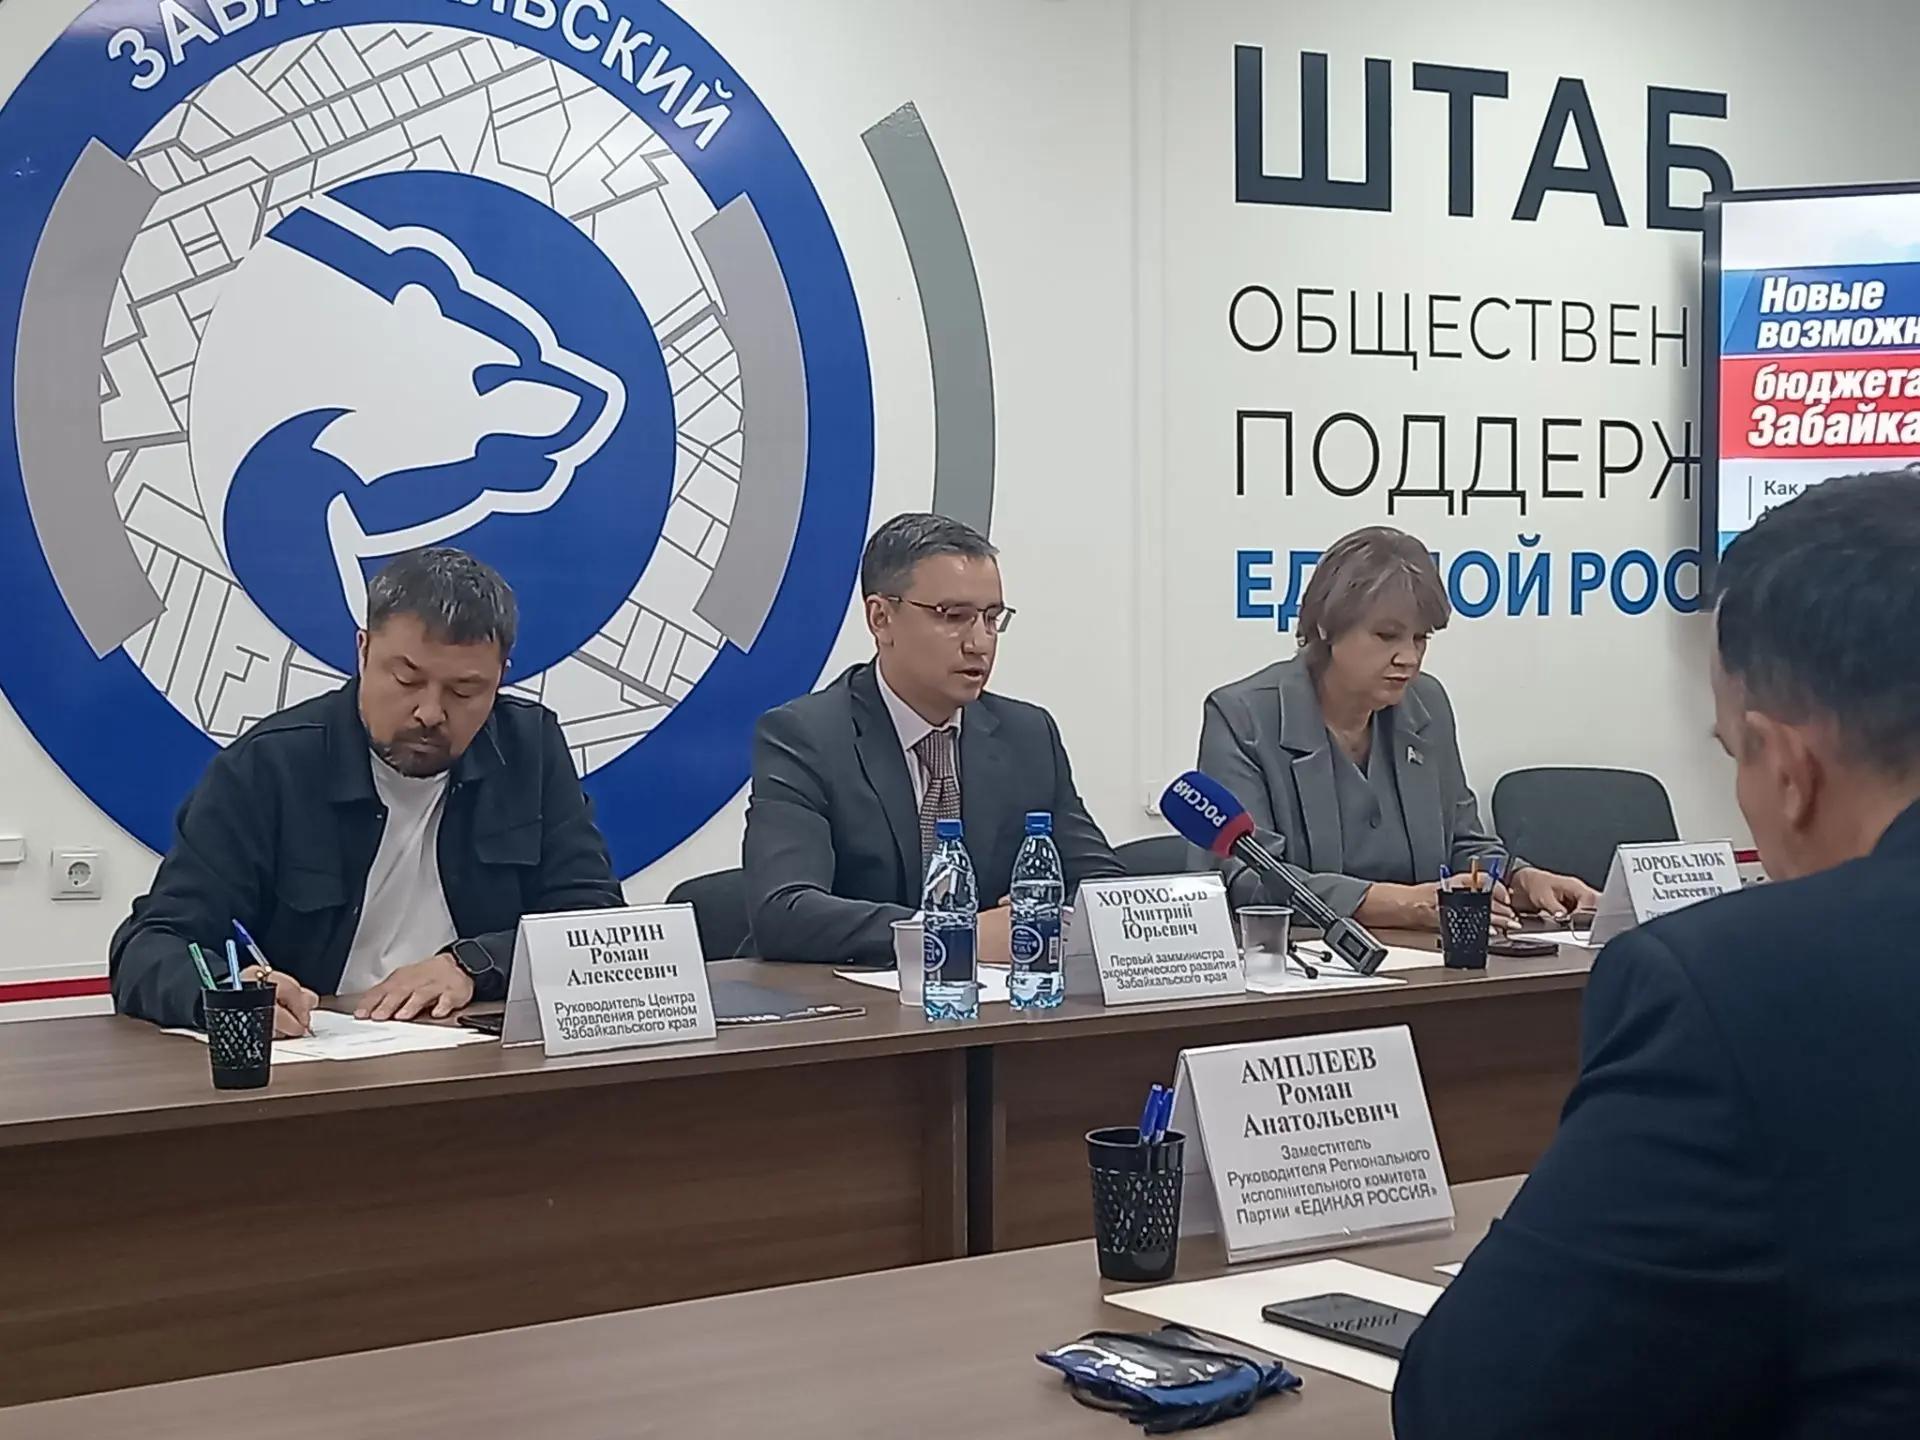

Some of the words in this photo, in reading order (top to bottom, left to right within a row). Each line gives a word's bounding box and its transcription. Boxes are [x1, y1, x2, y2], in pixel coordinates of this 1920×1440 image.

[1234, 44, 1734, 232] ШТАБ
[1759, 275, 1886, 314] Новые
[1228, 284, 1689, 371] ОБЩЕСТВЕН
[1756, 314, 1920, 350] возможн
[1752, 362, 1920, 405] бюджета
[1746, 401, 1920, 448] Забайка
[1235, 409, 1699, 516] ПОДДЕРЖ
[1764, 480, 1798, 495] Как
[1172, 779, 1228, 828] РОССИЯ
[1122, 903, 1193, 925] Дмитрий
[567, 923, 665, 948] ШАДРИН
[1122, 922, 1198, 942] Юрьевич
[590, 947, 650, 965] Роман
[1102, 963, 1188, 980] экономического
[1189, 959, 1237, 974] развития
[1110, 952, 1154, 967] Первый
[1156, 950, 1224, 964] замминистра
[566, 964, 678, 987] Алексеевич
[1117, 973, 1201, 990] Забайкальского
[1203, 971, 1228, 984] края
[554, 995, 646, 1017] Руководитель
[648, 992, 696, 1007] Центра
[556, 1011, 637, 1031] управления
[638, 1004, 698, 1023] регионом
[561, 1019, 665, 1041] Забайкальского
[668, 1016, 698, 1033] края
[1241, 1046, 1378, 1084] АМПЛЕЕВ
[1276, 1081, 1354, 1107] Роман
[1243, 1102, 1400, 1138] Анатольевич
[1280, 1137, 1372, 1161] Заместитель
[1226, 1160, 1328, 1187] Руководителя
[1329, 1149, 1431, 1174] Регионального
[1240, 1176, 1362, 1205] исполнительного
[1364, 1167, 1427, 1187] комитета
[1235, 1202, 1290, 1226] Партии
[1294, 1190, 1365, 1216] «ЕДИНАЯ
[1366, 1182, 1439, 1207] РОССИЯ»
